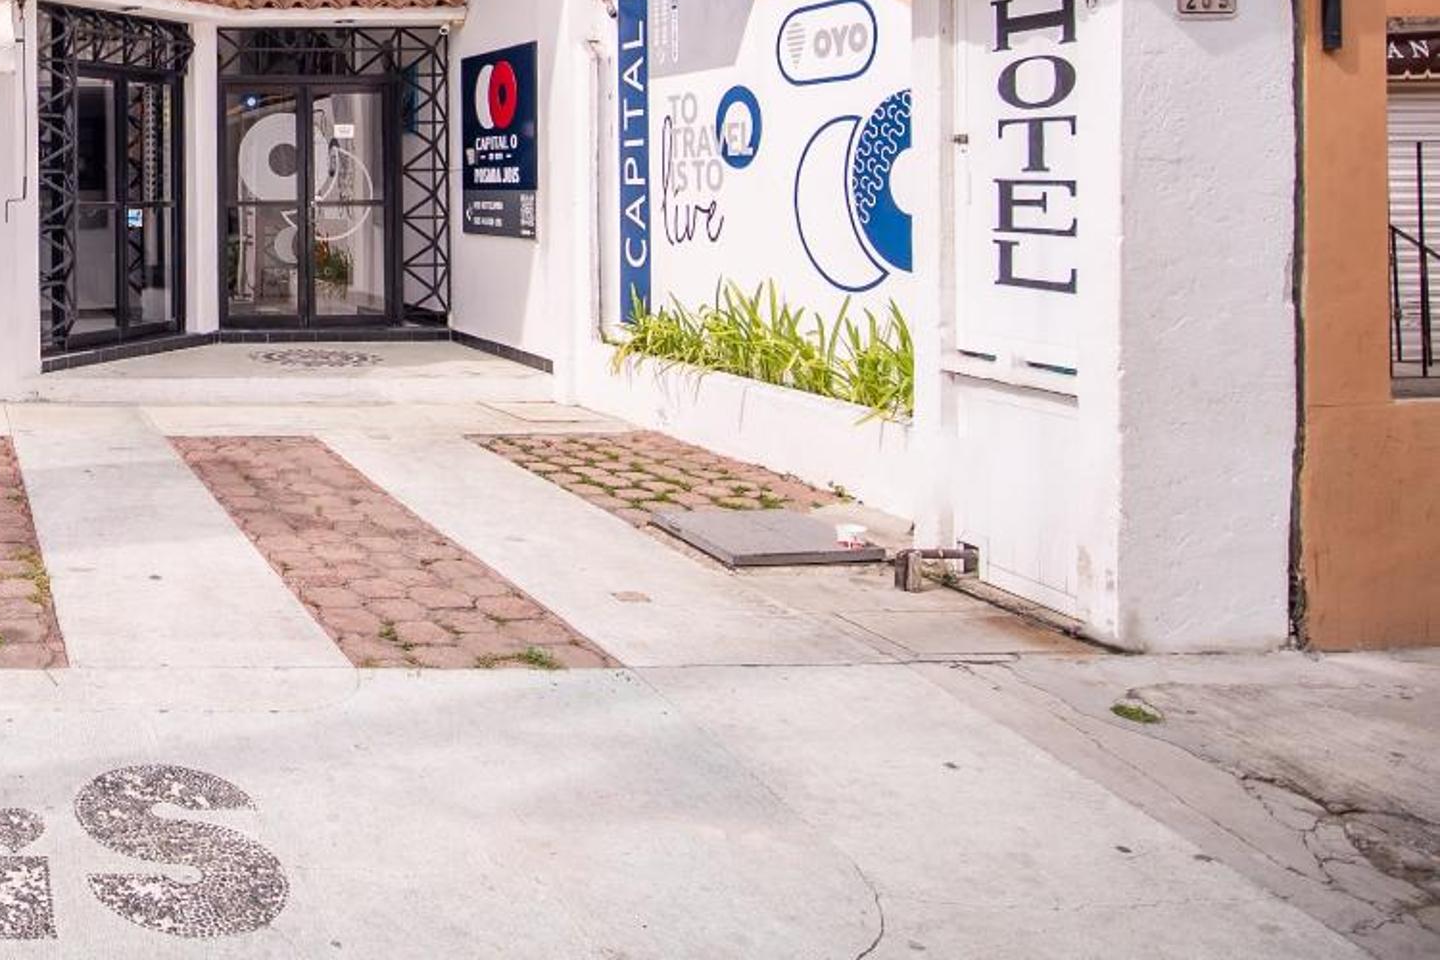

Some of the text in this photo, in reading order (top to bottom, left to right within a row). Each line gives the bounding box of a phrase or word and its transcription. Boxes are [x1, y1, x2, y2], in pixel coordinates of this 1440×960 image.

[813, 22, 868, 58] OYO
[668, 92, 698, 125] TO
[475, 136, 509, 151] CAPITAL
[623, 21, 647, 268] CAPITAL
[671, 119, 753, 159] TRAVEL
[661, 115, 724, 246] live
[670, 159, 723, 193] IS TO
